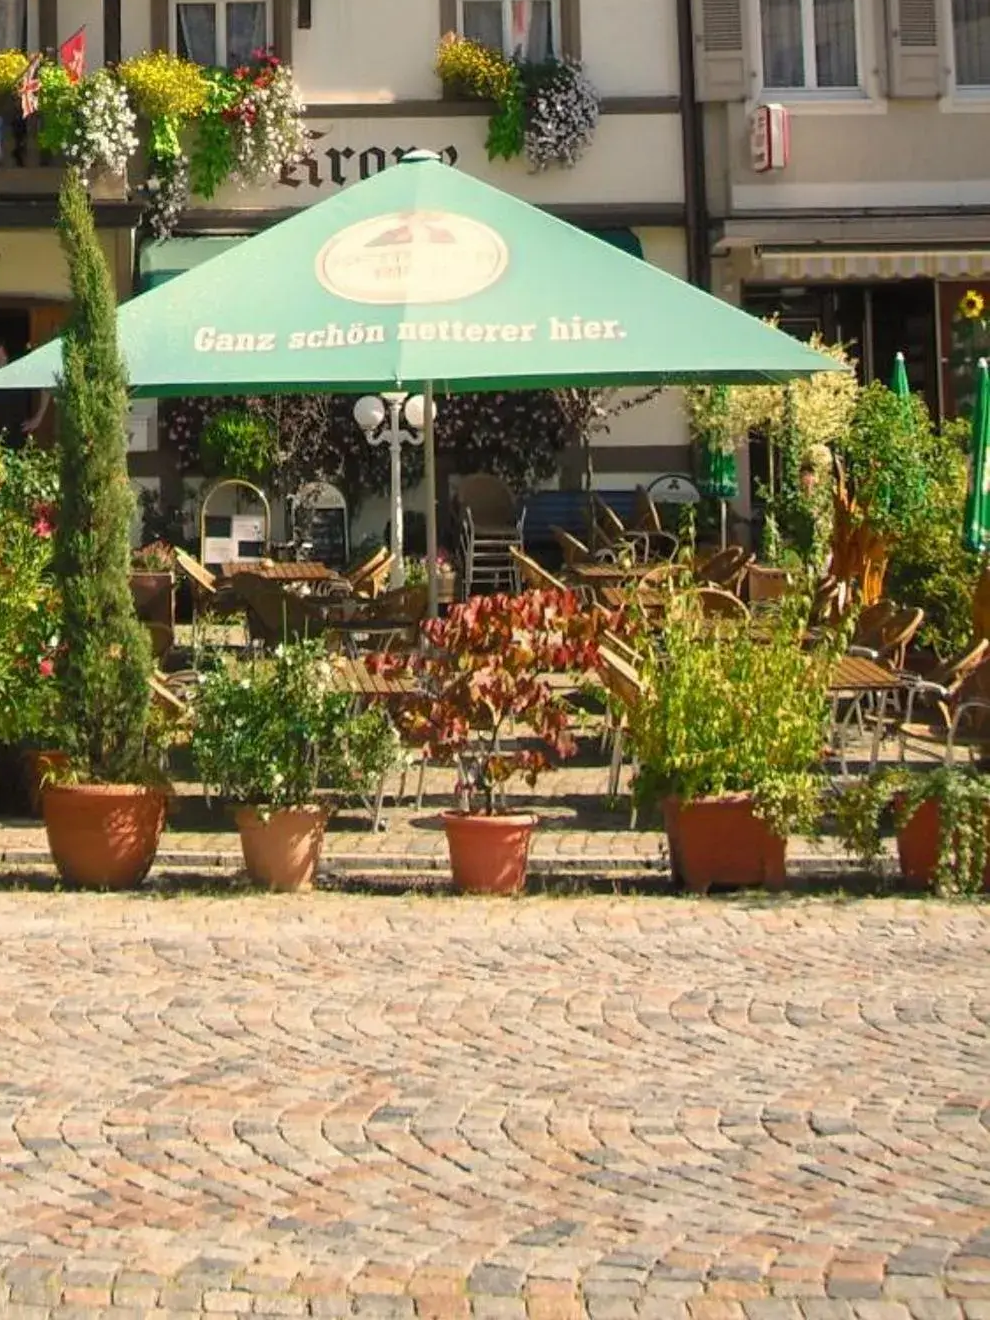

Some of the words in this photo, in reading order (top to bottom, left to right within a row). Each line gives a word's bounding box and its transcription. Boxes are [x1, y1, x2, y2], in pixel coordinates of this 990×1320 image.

[193, 326, 277, 352] Ganz
[287, 322, 385, 350] schön
[396, 320, 537, 342] netterer
[548, 313, 628, 341] hier.
